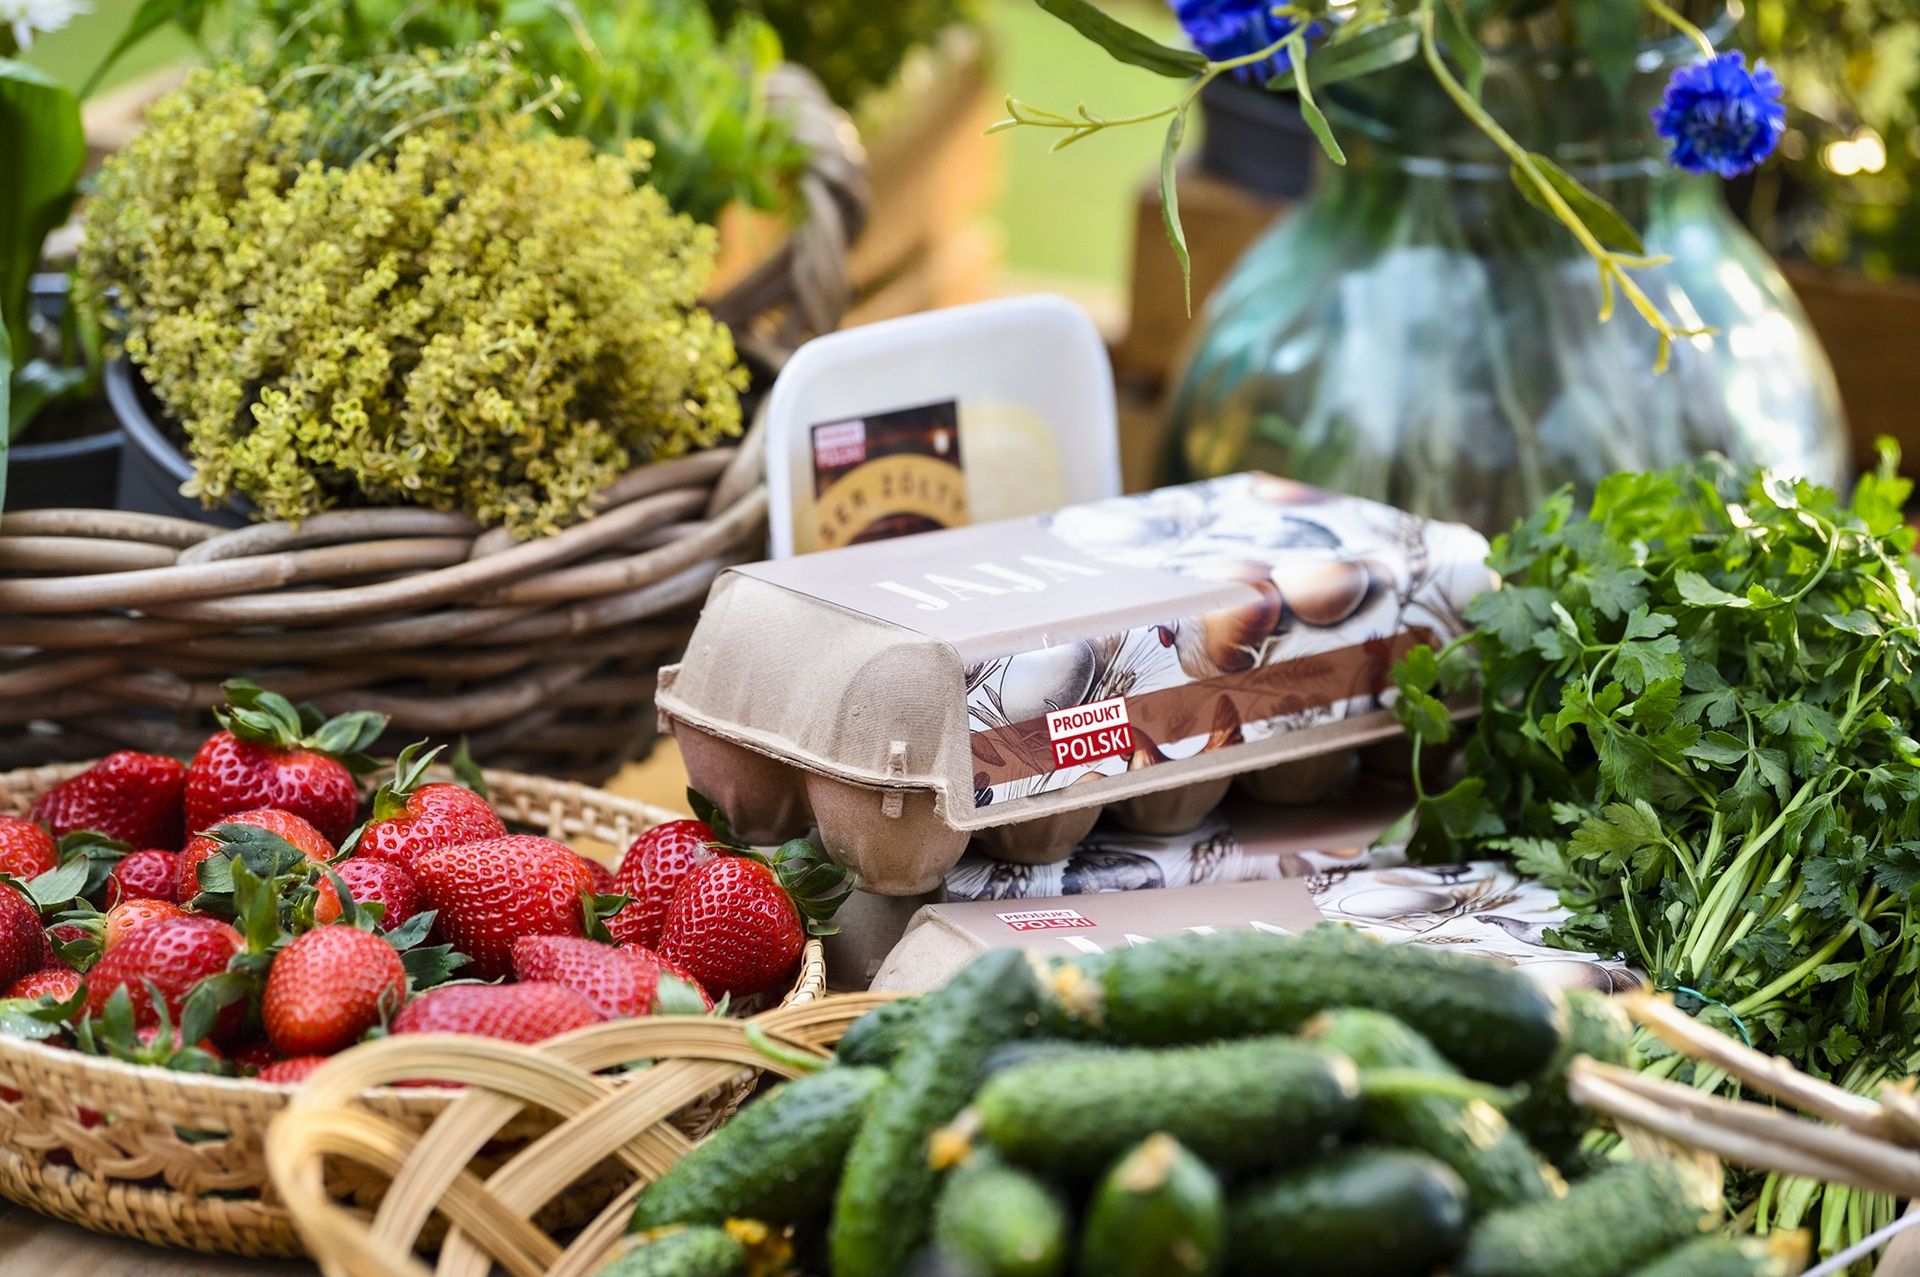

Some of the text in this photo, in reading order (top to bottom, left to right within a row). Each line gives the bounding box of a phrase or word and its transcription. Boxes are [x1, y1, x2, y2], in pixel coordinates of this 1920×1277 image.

[870, 554, 1104, 611] JAJA
[1053, 704, 1121, 733] PRODUKT
[1055, 727, 1132, 765] POLSKI
[1003, 911, 1075, 921] PRODUKT
[1012, 918, 1092, 930] POLSKI
